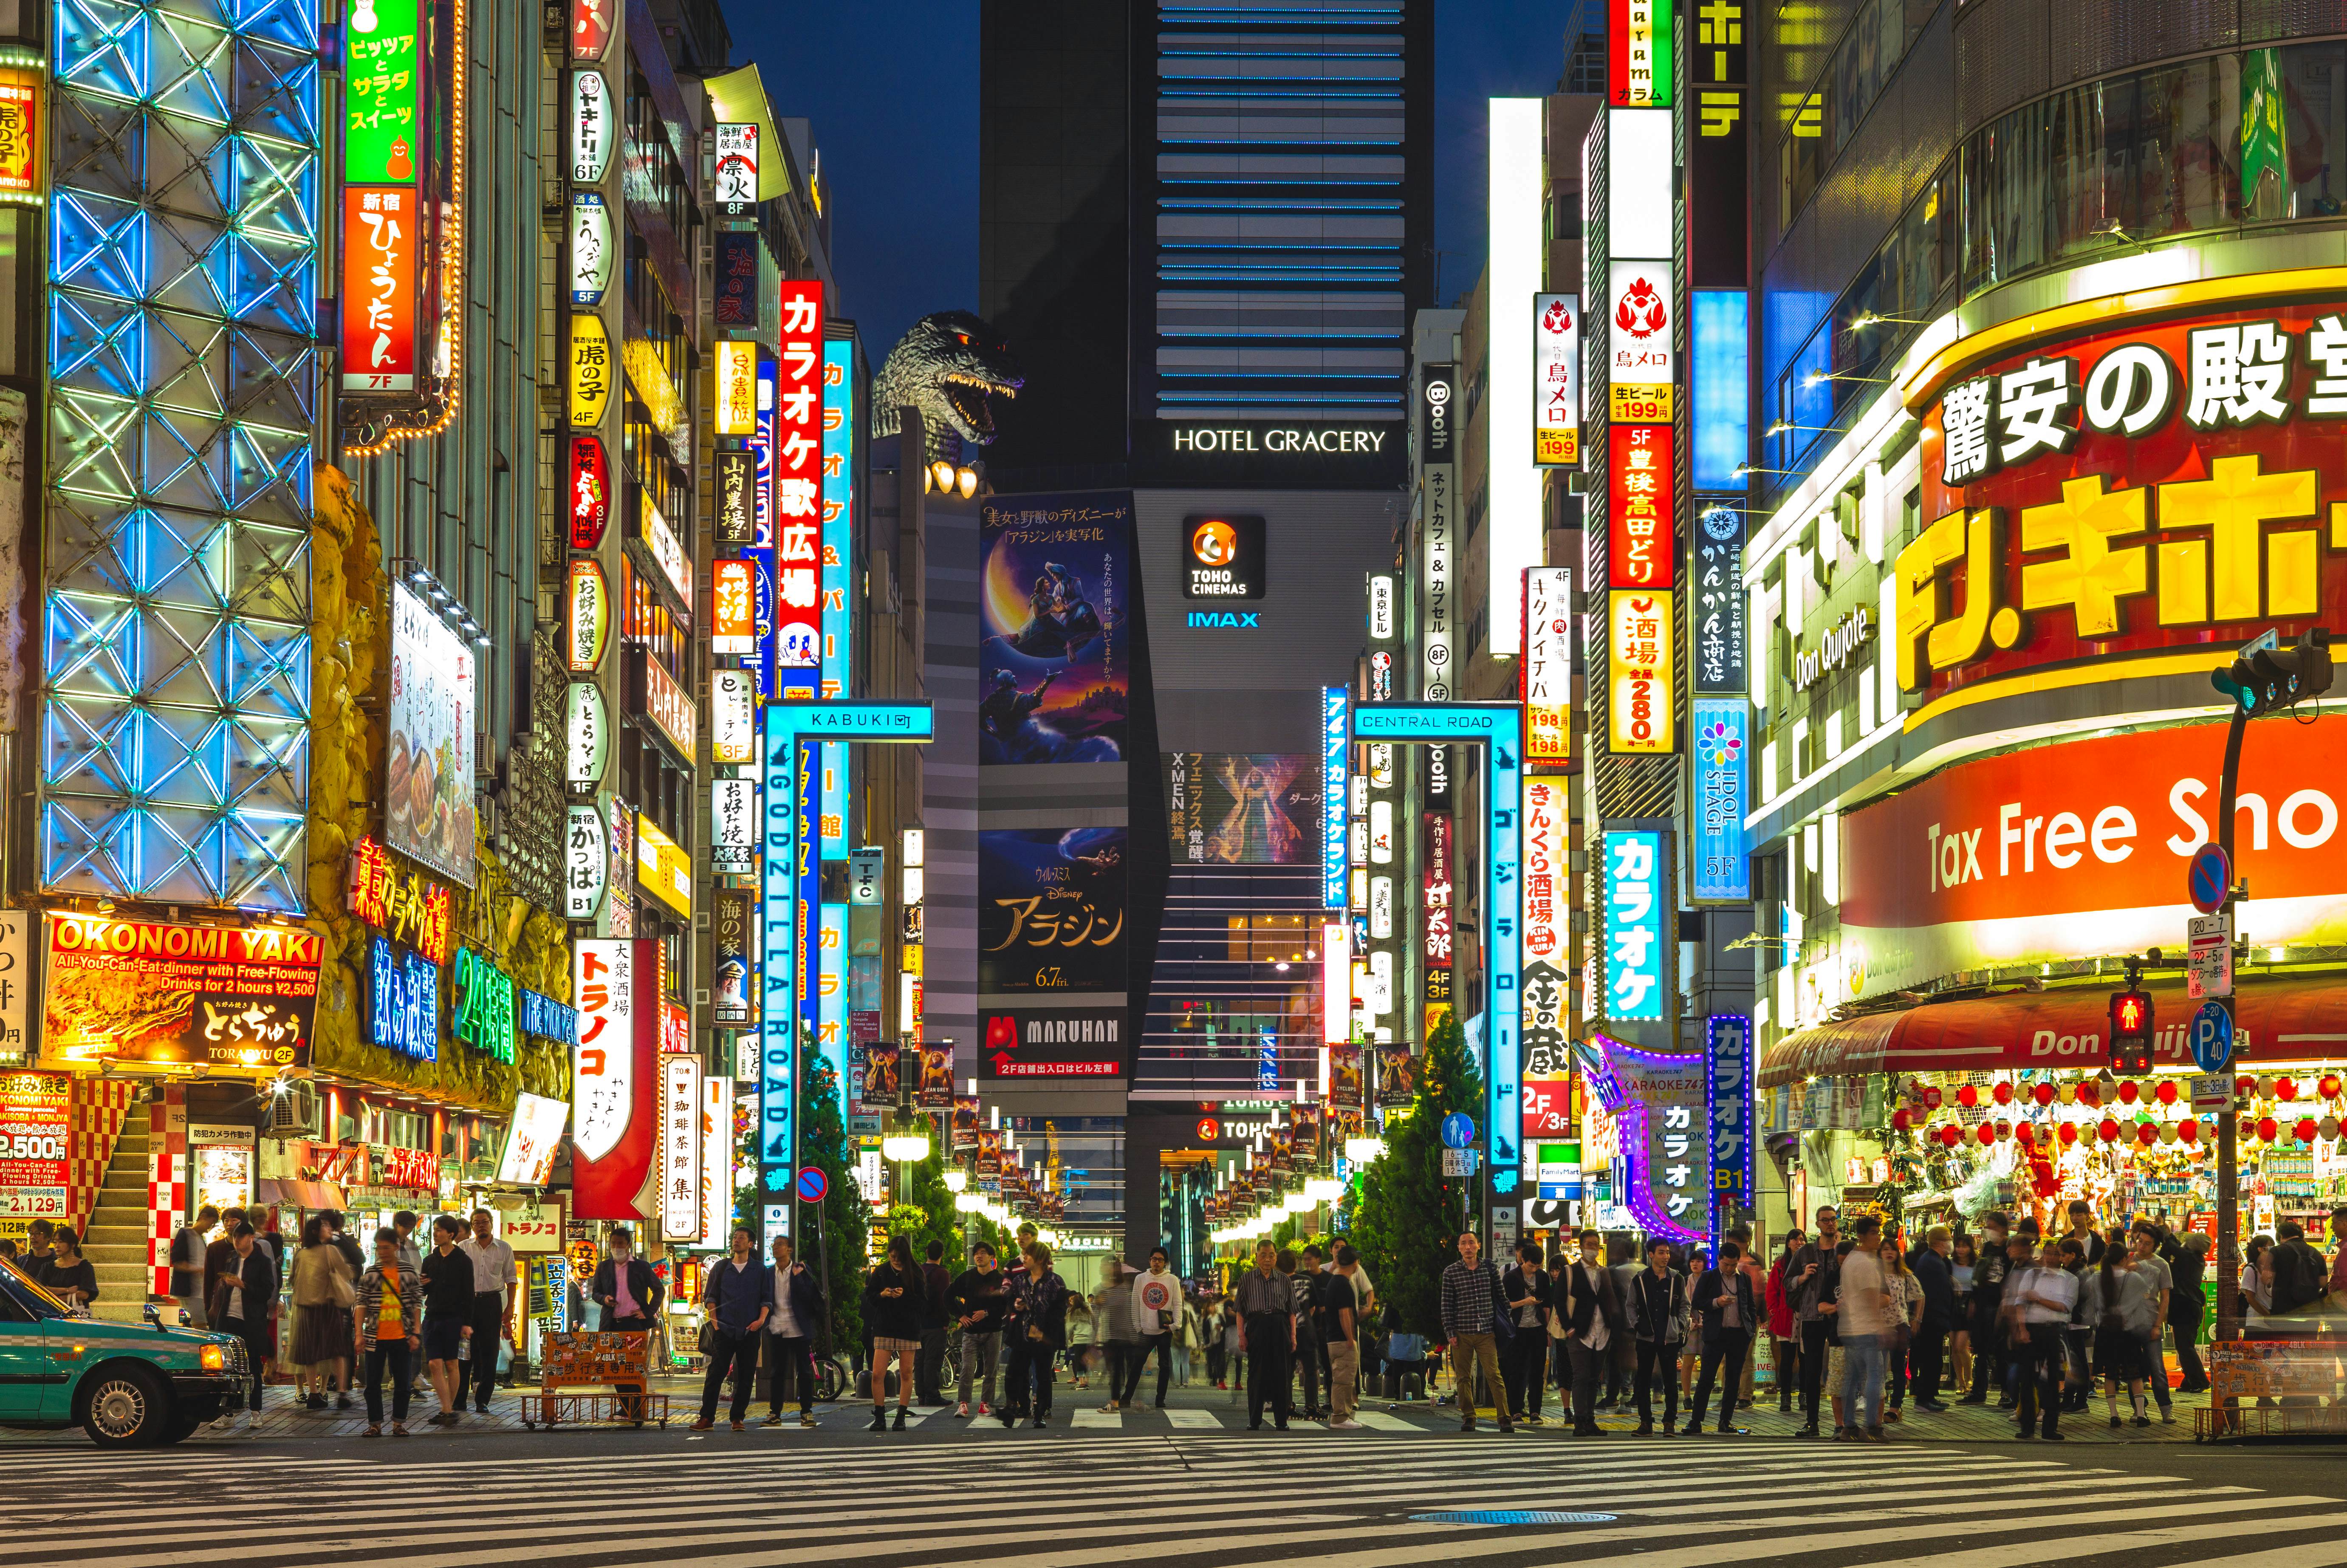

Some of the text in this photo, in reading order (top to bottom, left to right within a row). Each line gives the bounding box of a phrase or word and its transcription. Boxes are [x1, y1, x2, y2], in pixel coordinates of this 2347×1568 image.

[577, 47, 599, 57] 7F
[376, 60, 387, 71] と
[353, 71, 410, 96] サラダ
[375, 95, 387, 107] と
[1618, 88, 1663, 102] ガラム
[351, 107, 412, 130] スイーツ
[720, 127, 742, 137] 海鮮
[720, 139, 753, 150] 居酒屋
[575, 165, 601, 180] 6F
[363, 193, 400, 211] 新宿
[576, 195, 599, 205] 酒処
[728, 203, 743, 214] 8F
[359, 212, 401, 368] ひょうたん
[579, 293, 595, 302] 5F
[1616, 350, 1667, 367] 鳥メロ
[369, 376, 392, 388] 7F
[575, 345, 605, 401] 虎の子
[1548, 362, 1567, 423] 鳥メロ
[1616, 387, 1667, 400] 生ビール
[573, 412, 593, 422] 4F
[1426, 381, 1450, 449] Booth
[1623, 402, 1658, 418] 199
[1175, 429, 1385, 452] HOTEL GRACERY
[1540, 431, 1574, 440] 生ビール
[1631, 429, 1651, 445] 5F
[781, 294, 817, 608] カラオケ歌広場
[1545, 441, 1575, 455] 199
[722, 456, 747, 529] 山内農場
[983, 506, 1126, 528] 美女と野獣のディズニーが
[1625, 449, 1657, 583] 豊後高田どり
[728, 530, 740, 539] 5F
[1005, 527, 1104, 545] 「アラジン」を実写化
[1192, 570, 1231, 583] TOHO
[1555, 572, 1569, 582] 4F
[1192, 583, 1246, 595] CINEMAS
[1432, 559, 1445, 633] & カプセル
[579, 578, 596, 660] お好み焼き
[1376, 588, 1387, 633] 東京ビル
[1701, 545, 1726, 682] かんかん商店
[1188, 612, 1259, 628] IMAX
[1531, 579, 1549, 698] キタノイチバ
[1625, 617, 1659, 664] 酒場
[1797, 605, 1867, 693] Don Quijote
[571, 662, 593, 671] 2階
[1432, 650, 1445, 699] 8F 5F
[1629, 670, 1654, 680] 全品
[1631, 681, 1651, 740] 280
[1363, 717, 1493, 728] CENTRAL ROAD
[579, 705, 596, 777] とらそば
[723, 745, 743, 757] 3F
[573, 783, 591, 793] 1F
[1706, 770, 1722, 836] STAGE
[1722, 770, 1737, 825] IDOL
[571, 814, 594, 825] 新宿
[723, 782, 744, 845] お好み焼
[714, 847, 749, 862] 大阪家
[1433, 816, 1444, 879] 手作り居酒屋
[1528, 784, 1553, 924] きんくら酒場
[1928, 823, 1983, 893] Tax
[2000, 802, 2138, 877] Free
[571, 826, 595, 889] かっぱ
[1706, 856, 1735, 876] 5F
[859, 864, 873, 898] TFC
[1035, 866, 1070, 882] ウィル・スミス
[572, 898, 592, 910] B1
[721, 899, 741, 957] 海の家
[981, 896, 1123, 951] アラジン
[1424, 881, 1452, 959] 甘太郎
[1613, 838, 1655, 1011] カラオケ
[1530, 927, 1548, 936] KIN
[57, 919, 320, 963] OKONOMI YAKI
[1528, 944, 1555, 952] KURA
[1495, 809, 1516, 1099] ゴジラロード
[1884, 949, 1914, 977] Quijote
[56, 954, 317, 983] All-You-Can-Eat dinner with Free-Flowing
[1428, 970, 1449, 983] 4F
[160, 977, 272, 994] Drinks for 2 hours
[613, 944, 629, 1016] 大衆酒場
[1428, 985, 1449, 999] 3F
[215, 1001, 248, 1009] お好み焼き
[580, 952, 609, 1076] トラノコ
[2202, 1007, 2219, 1018] 7-20
[1027, 1020, 1118, 1043] MARUHAN
[2199, 1019, 2223, 1062] P 40
[2031, 1031, 2098, 1057] Don
[277, 1050, 292, 1060] 2F
[767, 1017, 789, 1122] ROAD
[1002, 1063, 1112, 1074] 2F店舗出入口はビル左側
[1714, 1024, 1744, 1161] カラオケ
[45, 1097, 68, 1107] YAKI
[37, 1114, 68, 1122] MONJYA
[194, 1129, 252, 1139] 防犯カメラ作動中
[675, 1100, 689, 1169] 珈琲茶館
[1997, 1124, 2009, 1136] 祭
[1664, 1106, 1693, 1217] カラオケ
[1541, 1167, 1580, 1177] FamilyMart
[1714, 1169, 1743, 1189] B1
[670, 1178, 692, 1201] 集
[175, 1220, 182, 1228] 2F
[507, 1223, 557, 1235] トラノコ
[602, 1353, 616, 1362] 4BLK
